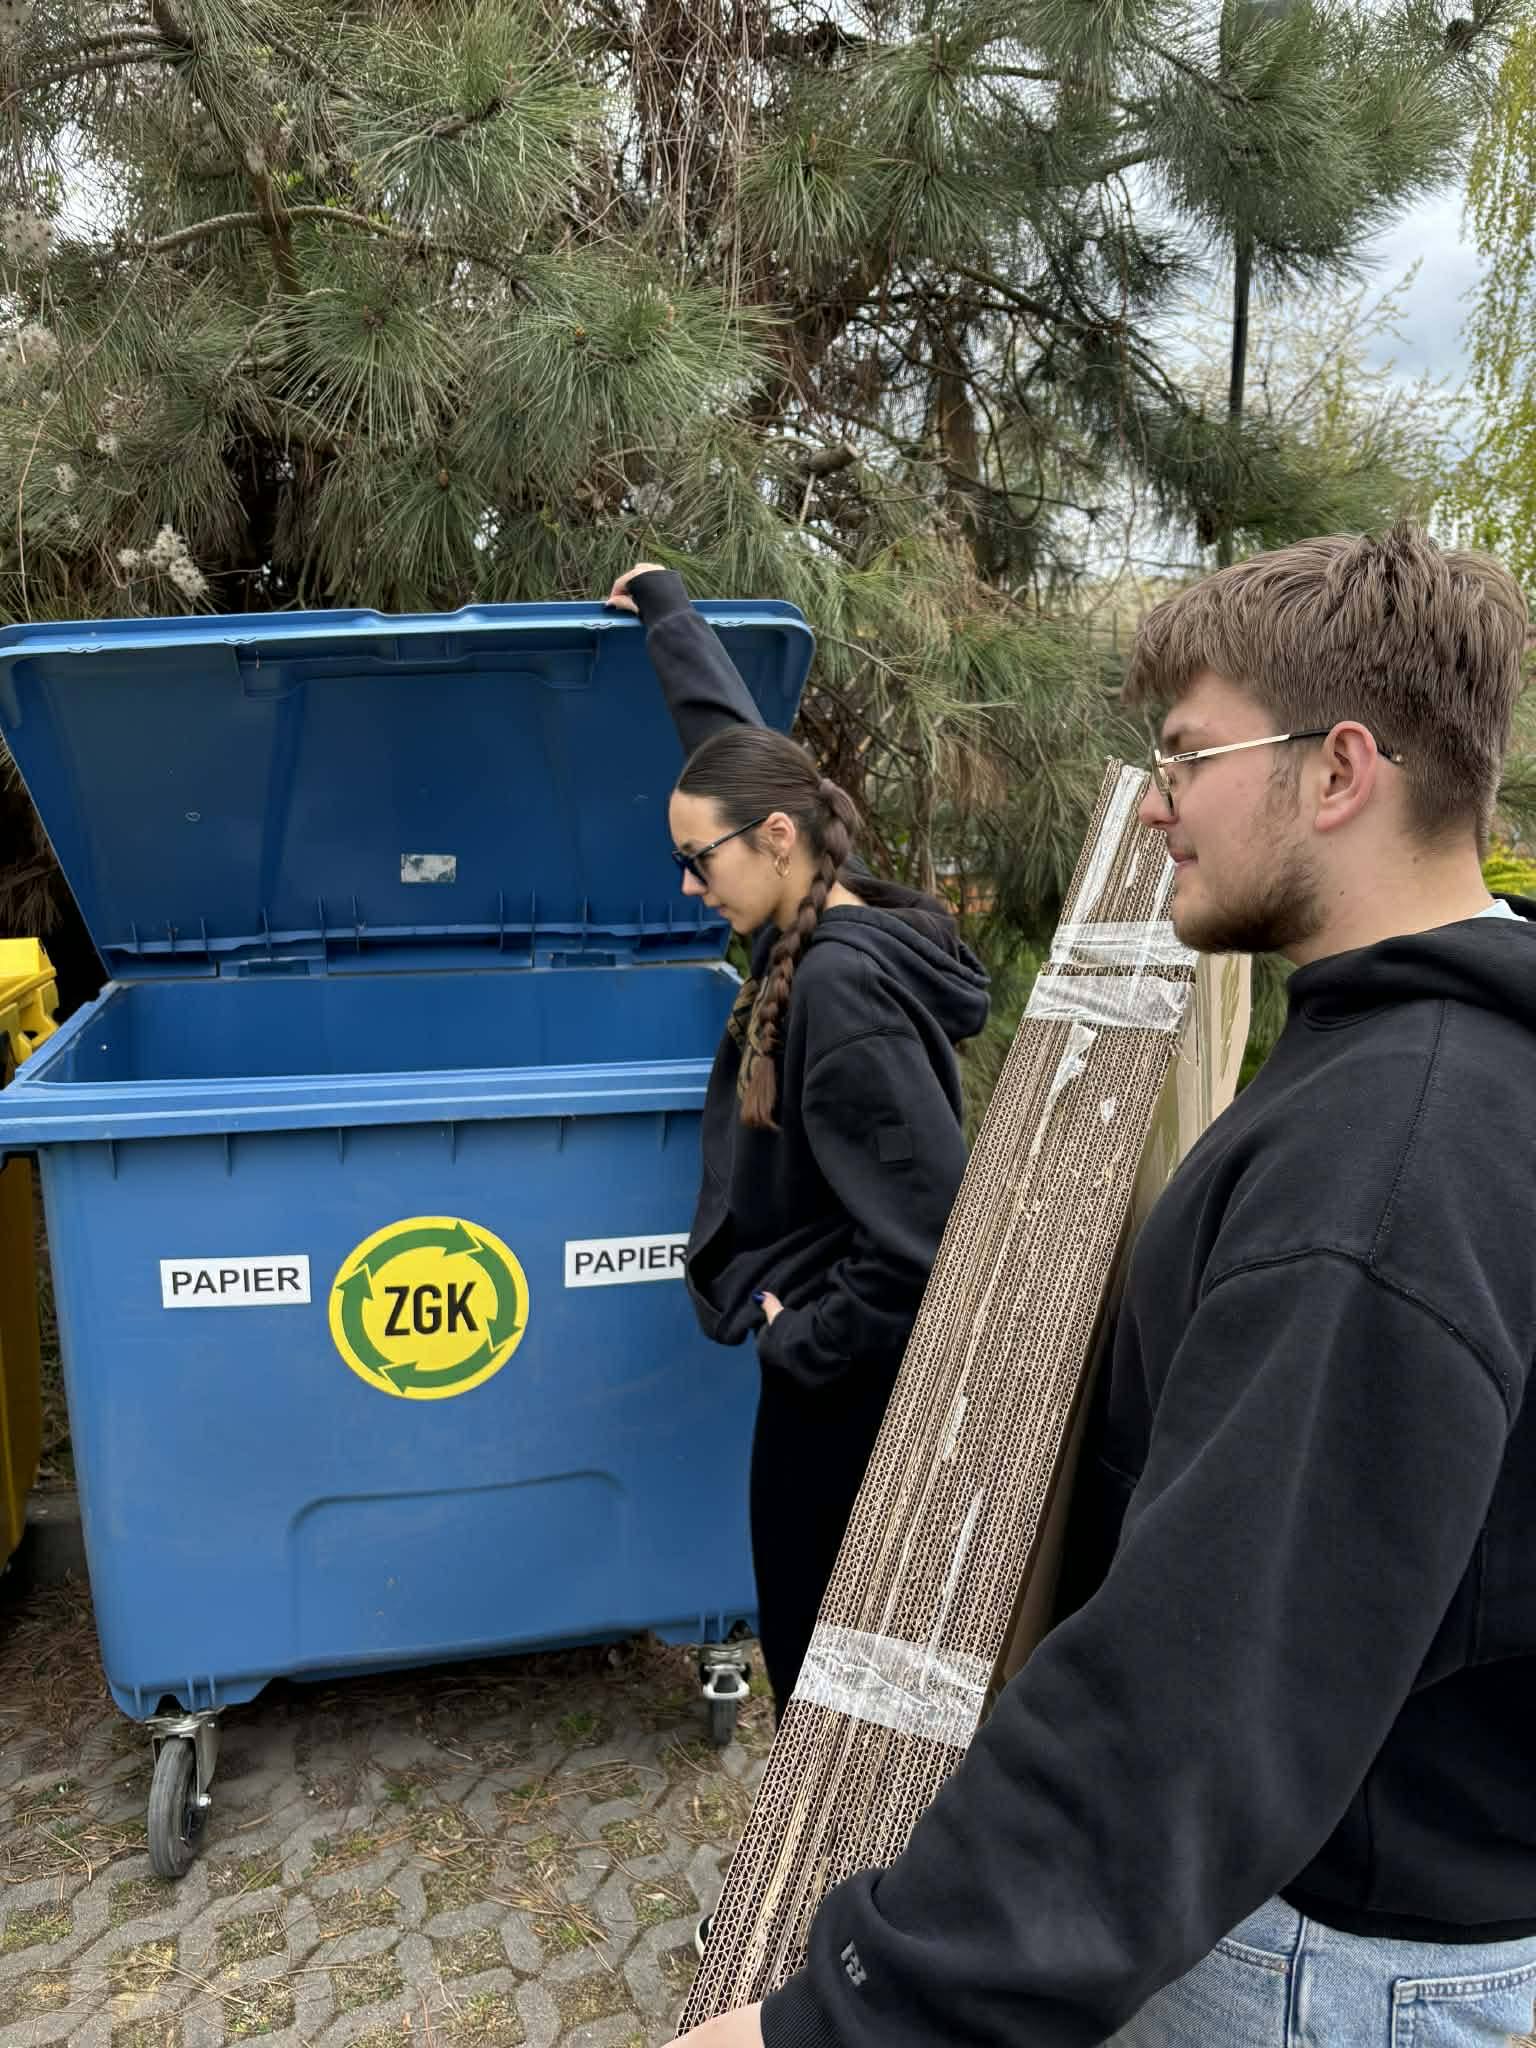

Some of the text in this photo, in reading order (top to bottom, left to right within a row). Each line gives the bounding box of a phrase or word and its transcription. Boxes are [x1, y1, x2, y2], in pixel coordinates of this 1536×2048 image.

[575, 1244, 687, 1275] PAPIER
[171, 1267, 302, 1295] PAPIER
[384, 1281, 479, 1336] ZGK
